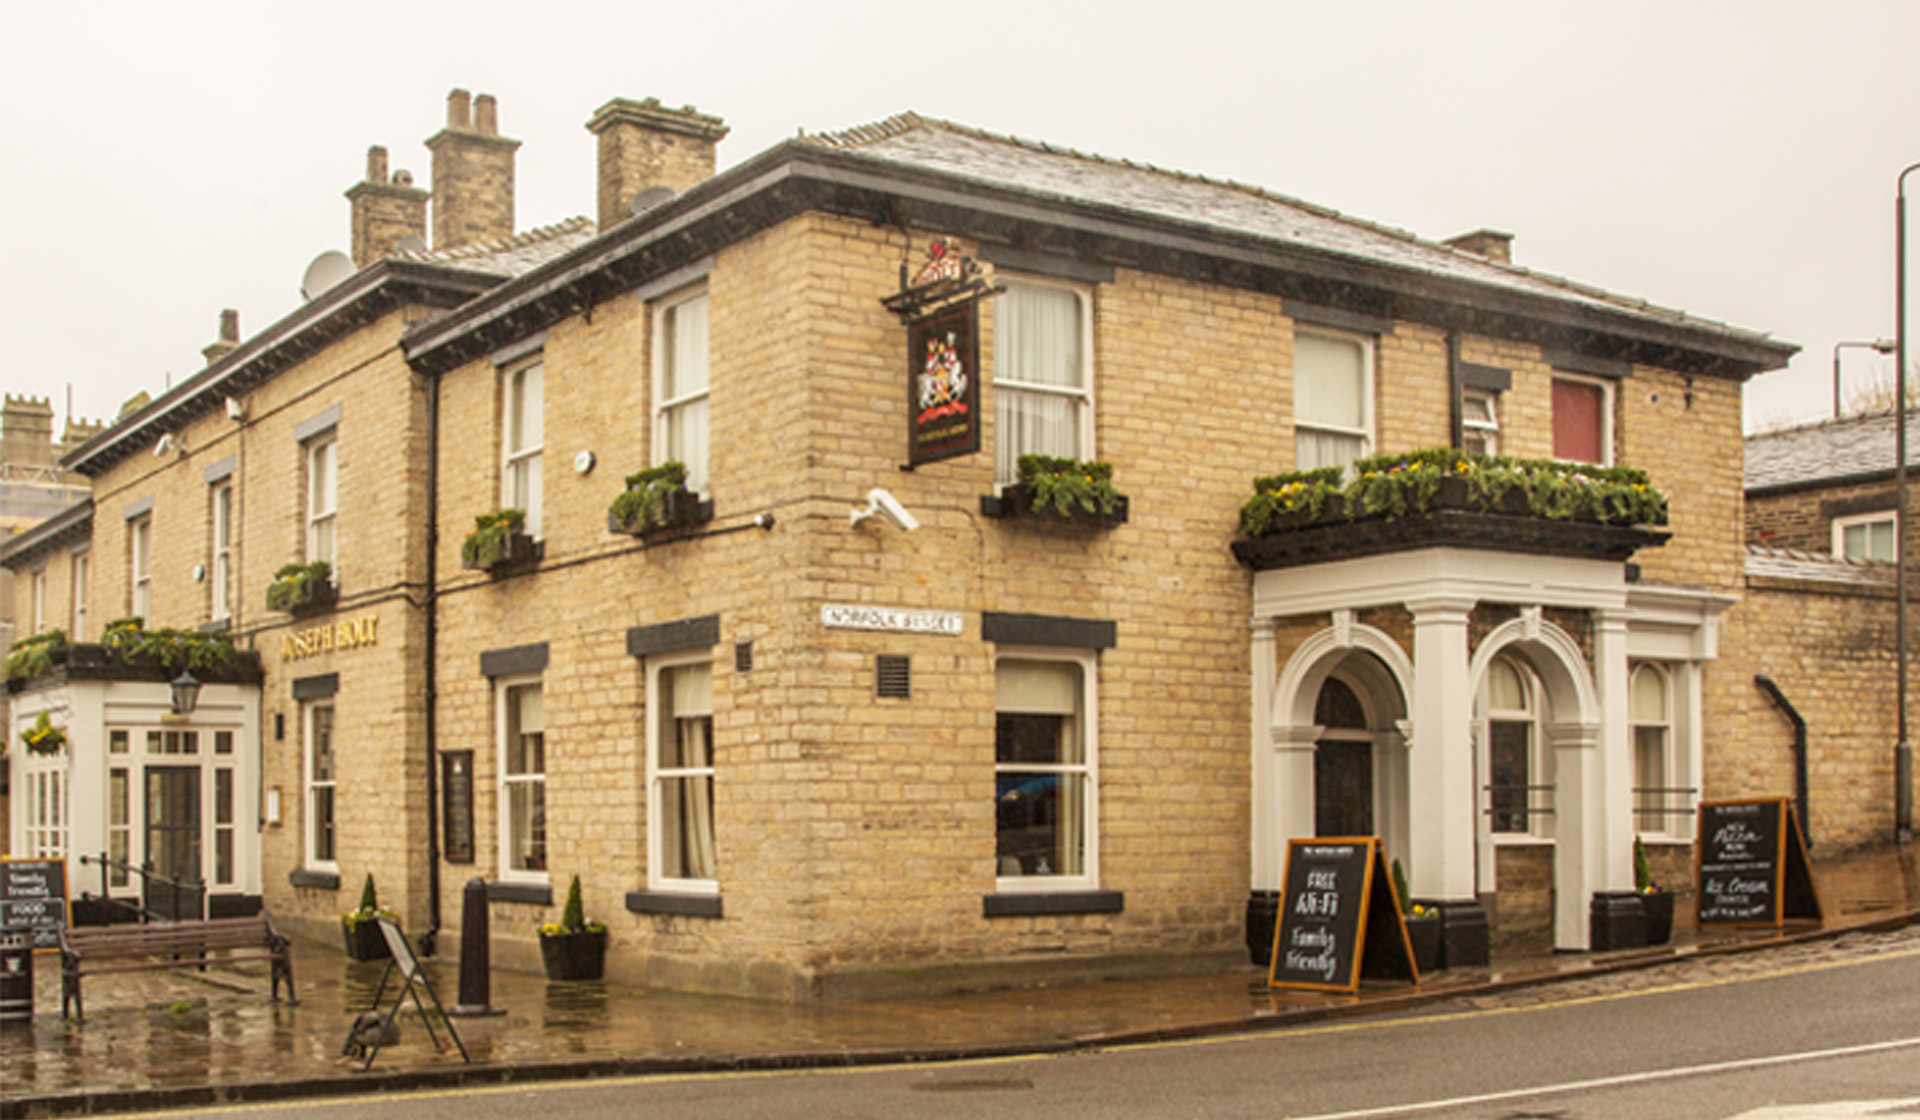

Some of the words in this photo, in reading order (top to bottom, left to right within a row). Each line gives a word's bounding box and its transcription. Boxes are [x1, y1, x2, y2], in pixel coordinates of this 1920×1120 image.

[281, 624, 335, 661] JOSEPH
[335, 615, 378, 650] HOLT
[1307, 871, 1337, 890] FREE
